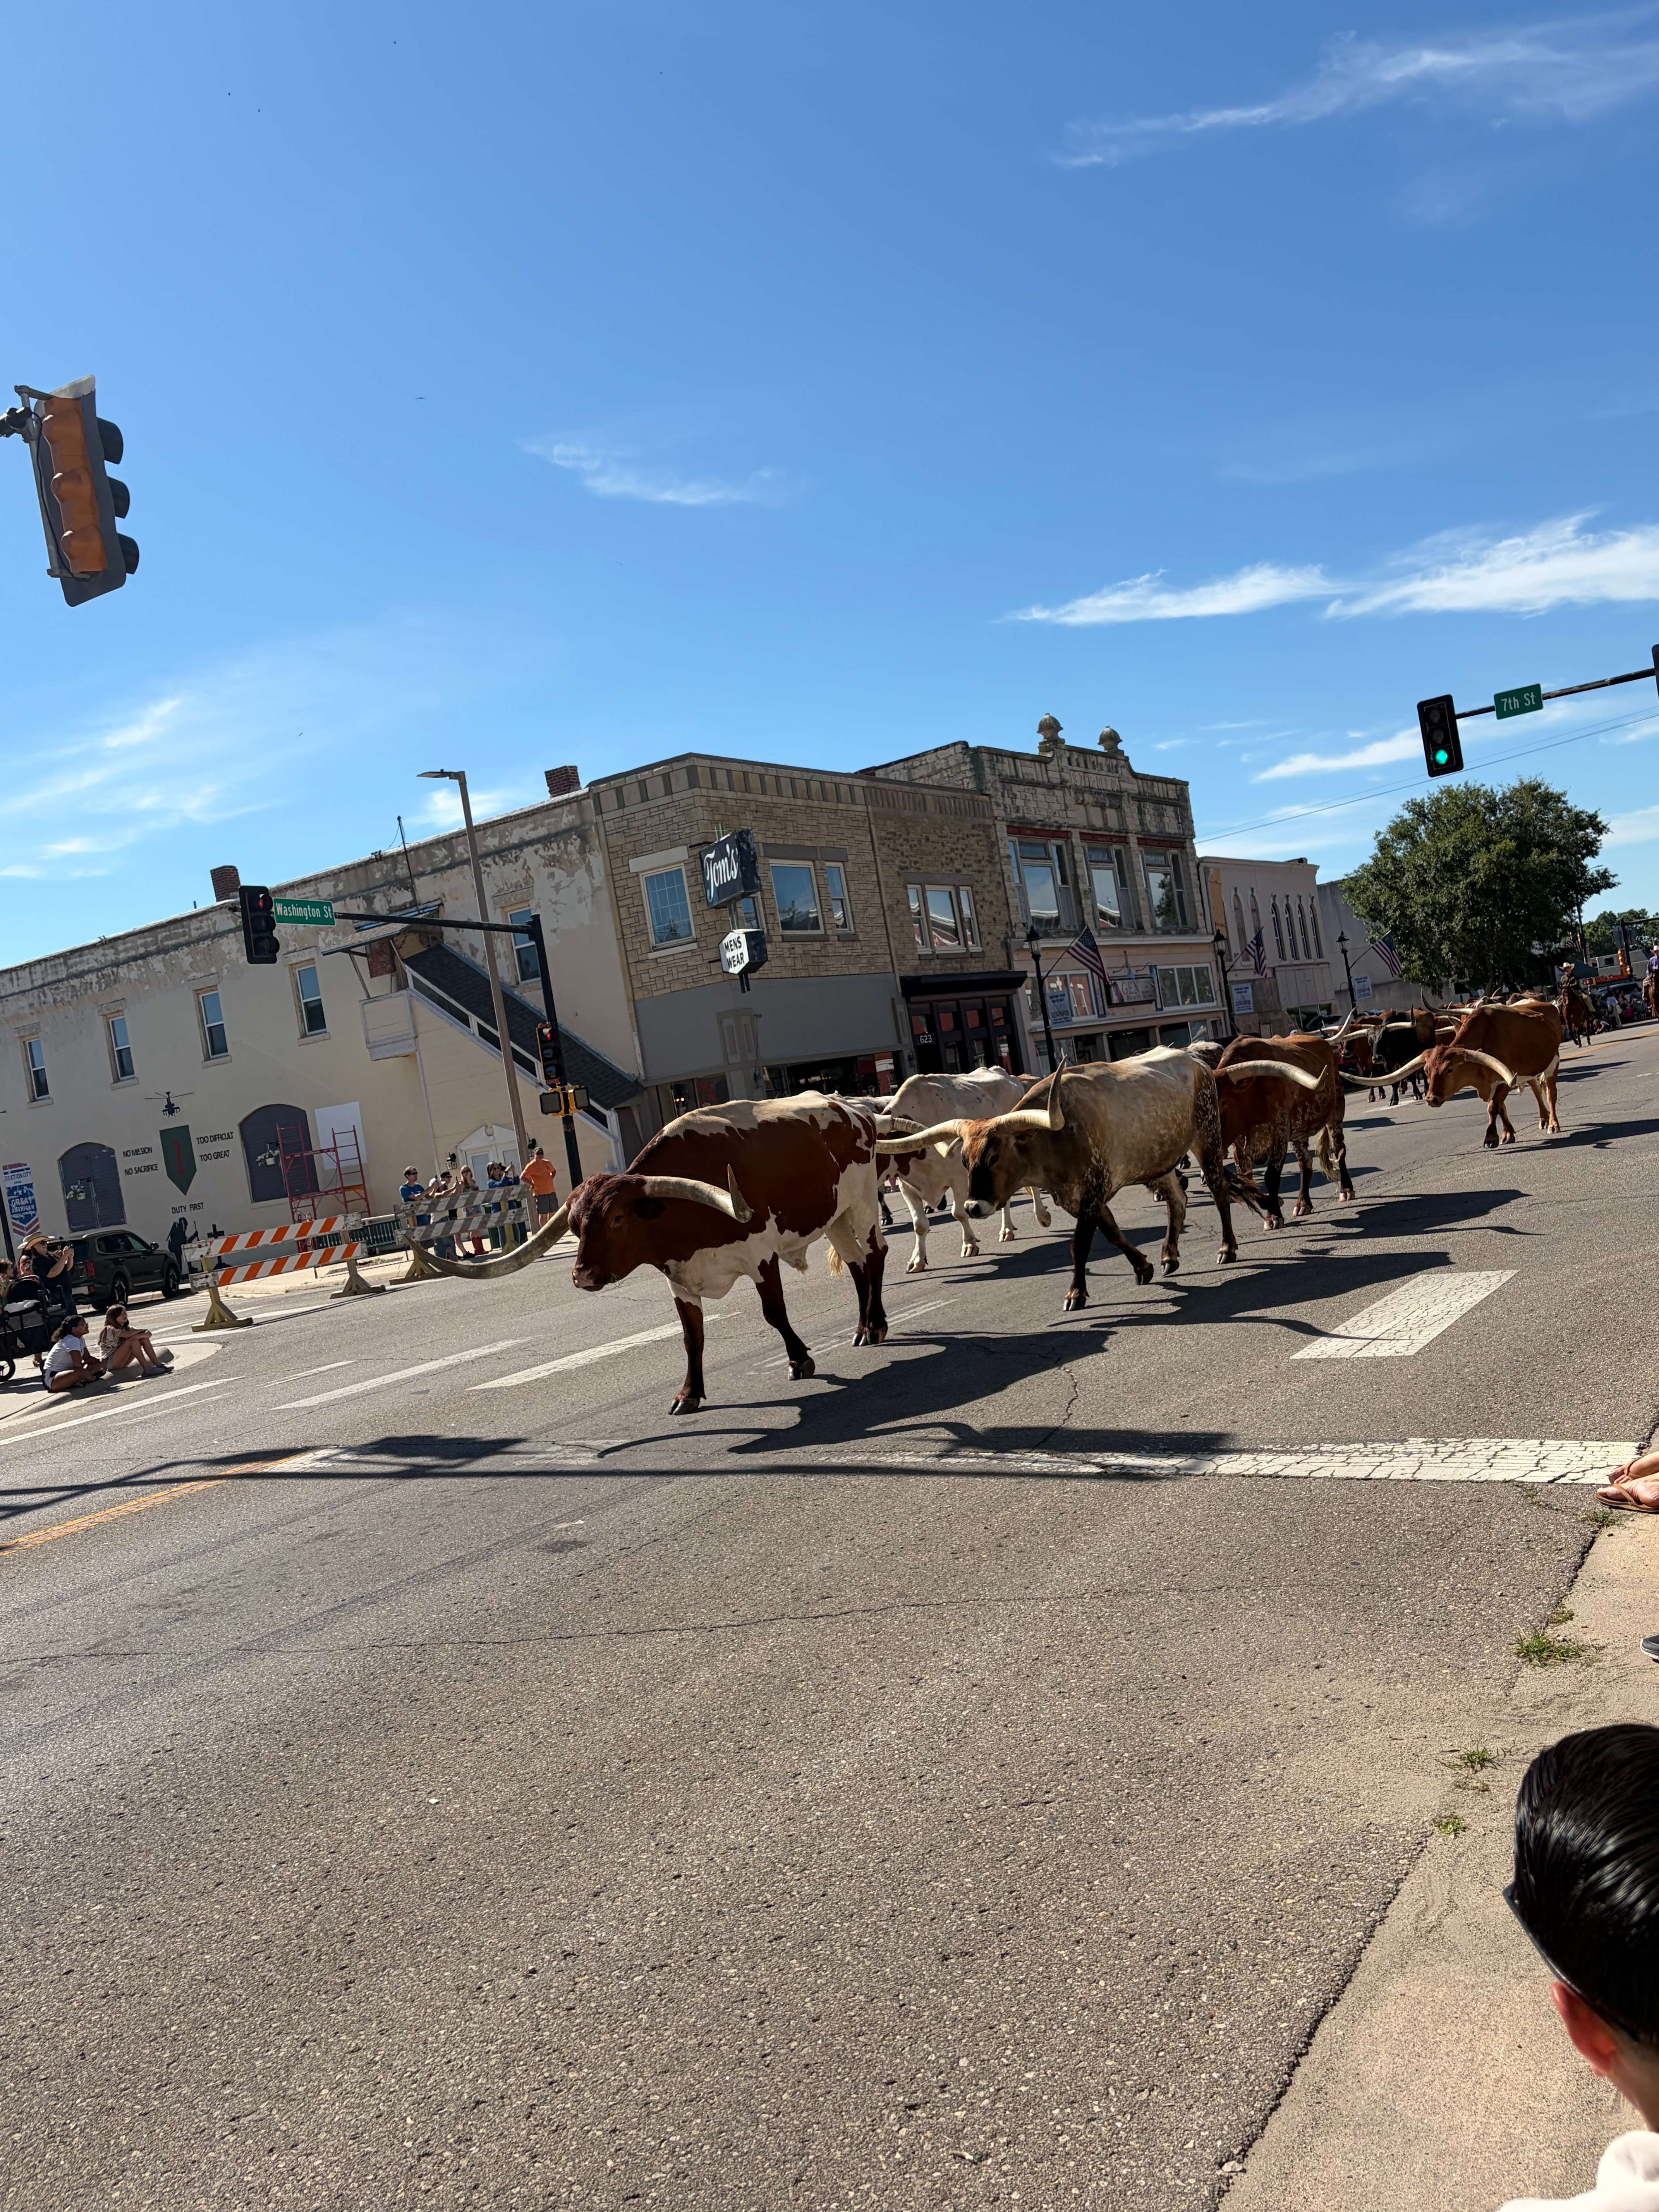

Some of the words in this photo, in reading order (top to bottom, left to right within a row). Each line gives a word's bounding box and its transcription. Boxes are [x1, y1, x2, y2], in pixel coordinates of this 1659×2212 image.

[1501, 696, 1520, 711] 7th
[1523, 692, 1536, 706] St
[703, 843, 738, 902] Tom's
[275, 903, 321, 920] Washington
[323, 905, 332, 918] St
[724, 936, 742, 953] MENS
[726, 952, 745, 969] WEAR
[920, 1034, 933, 1044] 623
[196, 1135, 209, 1144] TOO
[210, 1132, 234, 1142] DIFFICULT
[123, 1150, 131, 1158] NO
[132, 1147, 153, 1156] MISSION
[199, 1153, 212, 1162] TOO
[213, 1150, 230, 1159] GREAT
[124, 1168, 133, 1176] NO
[134, 1164, 158, 1174] SACRIFICE
[11, 1196, 32, 1207] GREAT
[12, 1204, 35, 1213] AMERICAN
[172, 1205, 187, 1214] DUTY
[189, 1202, 204, 1211] FIRST
